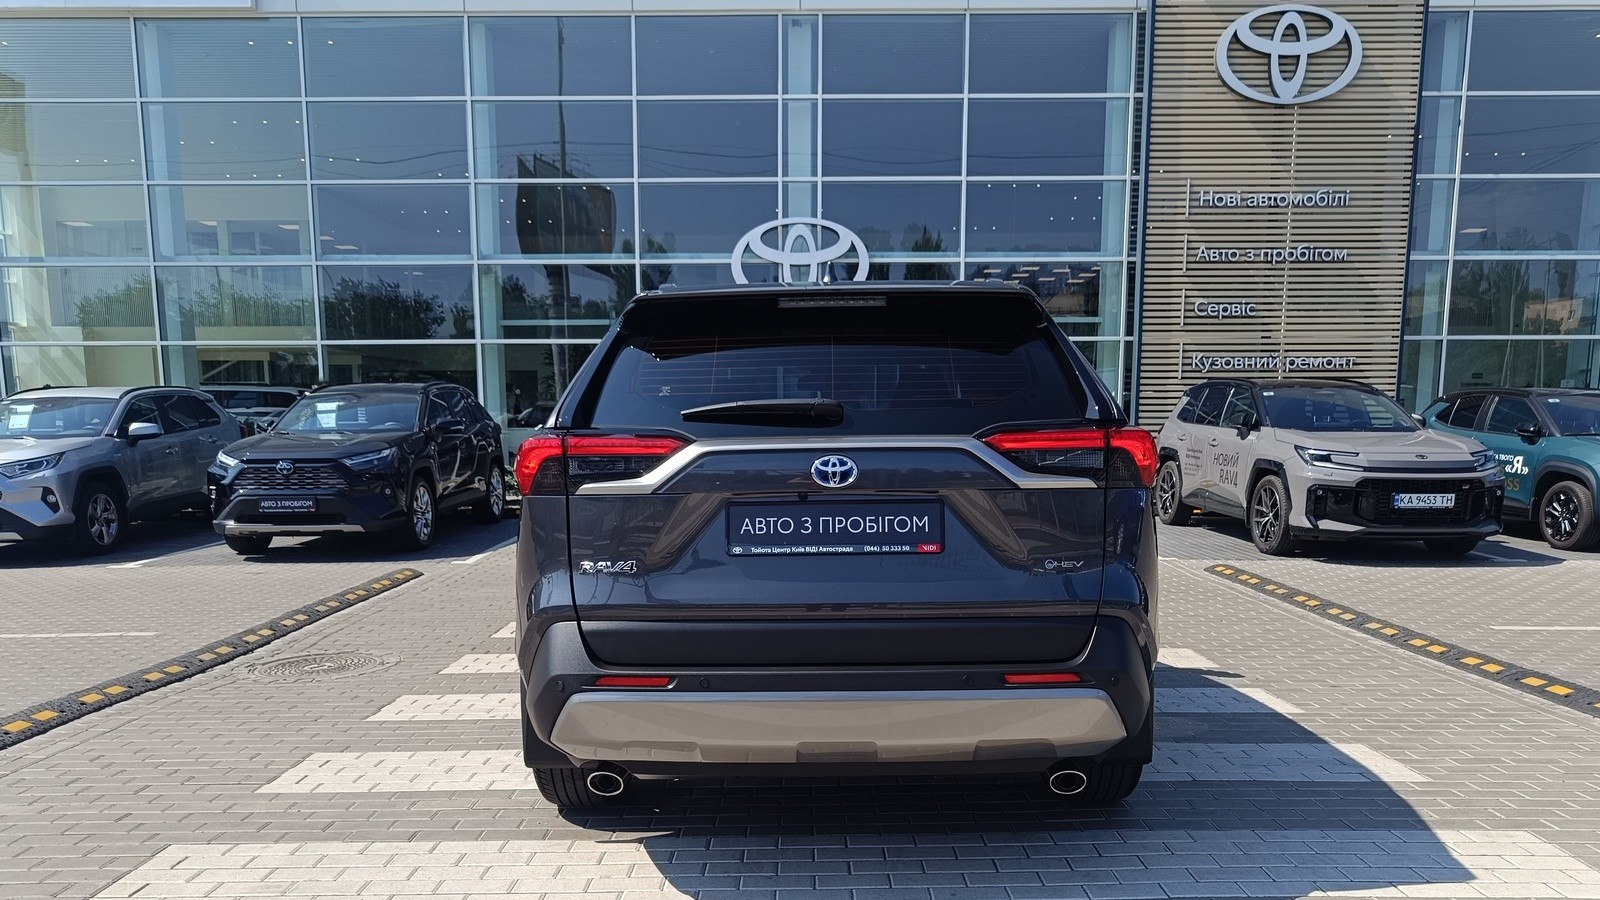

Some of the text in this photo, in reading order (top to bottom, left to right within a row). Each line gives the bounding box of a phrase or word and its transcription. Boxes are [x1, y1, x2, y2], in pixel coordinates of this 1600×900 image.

[1199, 189, 1351, 208] Нові автомобілі
[1195, 244, 1348, 265] Авто з пробігом
[1194, 299, 1257, 320] Сервіс
[1191, 353, 1356, 373] Кузовний ремонт
[1213, 452, 1240, 468] НОВИЙ
[1219, 469, 1238, 488] RAV4
[1400, 496, 1453, 505] KA 9453 TH
[740, 516, 929, 535] АВТО З ПРОБІГОМ
[579, 560, 637, 574] RAV4
